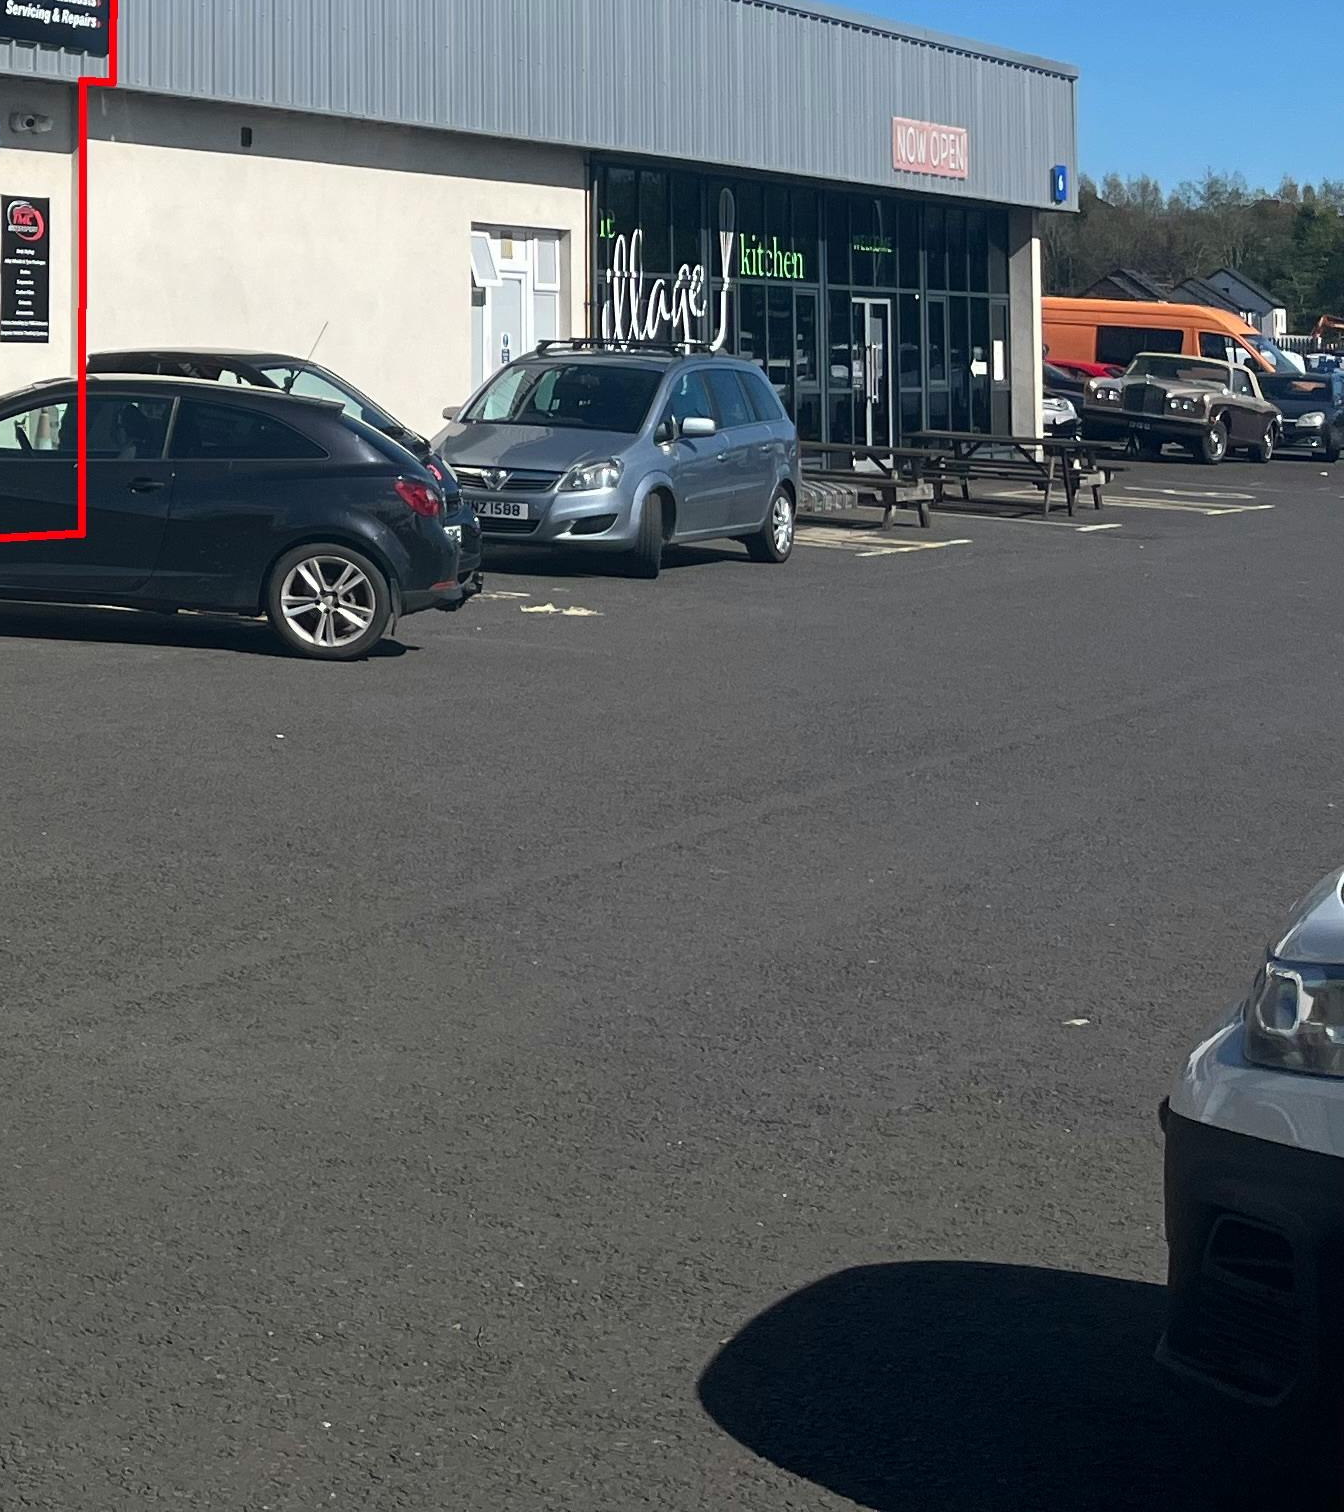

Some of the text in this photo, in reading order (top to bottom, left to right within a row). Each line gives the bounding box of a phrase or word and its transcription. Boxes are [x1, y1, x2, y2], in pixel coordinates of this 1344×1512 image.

[5, 0, 97, 28] Servicing & Repairs
[897, 125, 964, 170] NOW OPEN
[1057, 174, 1064, 191] 6
[739, 233, 804, 279] kitchen
[490, 503, 520, 517] 1588
